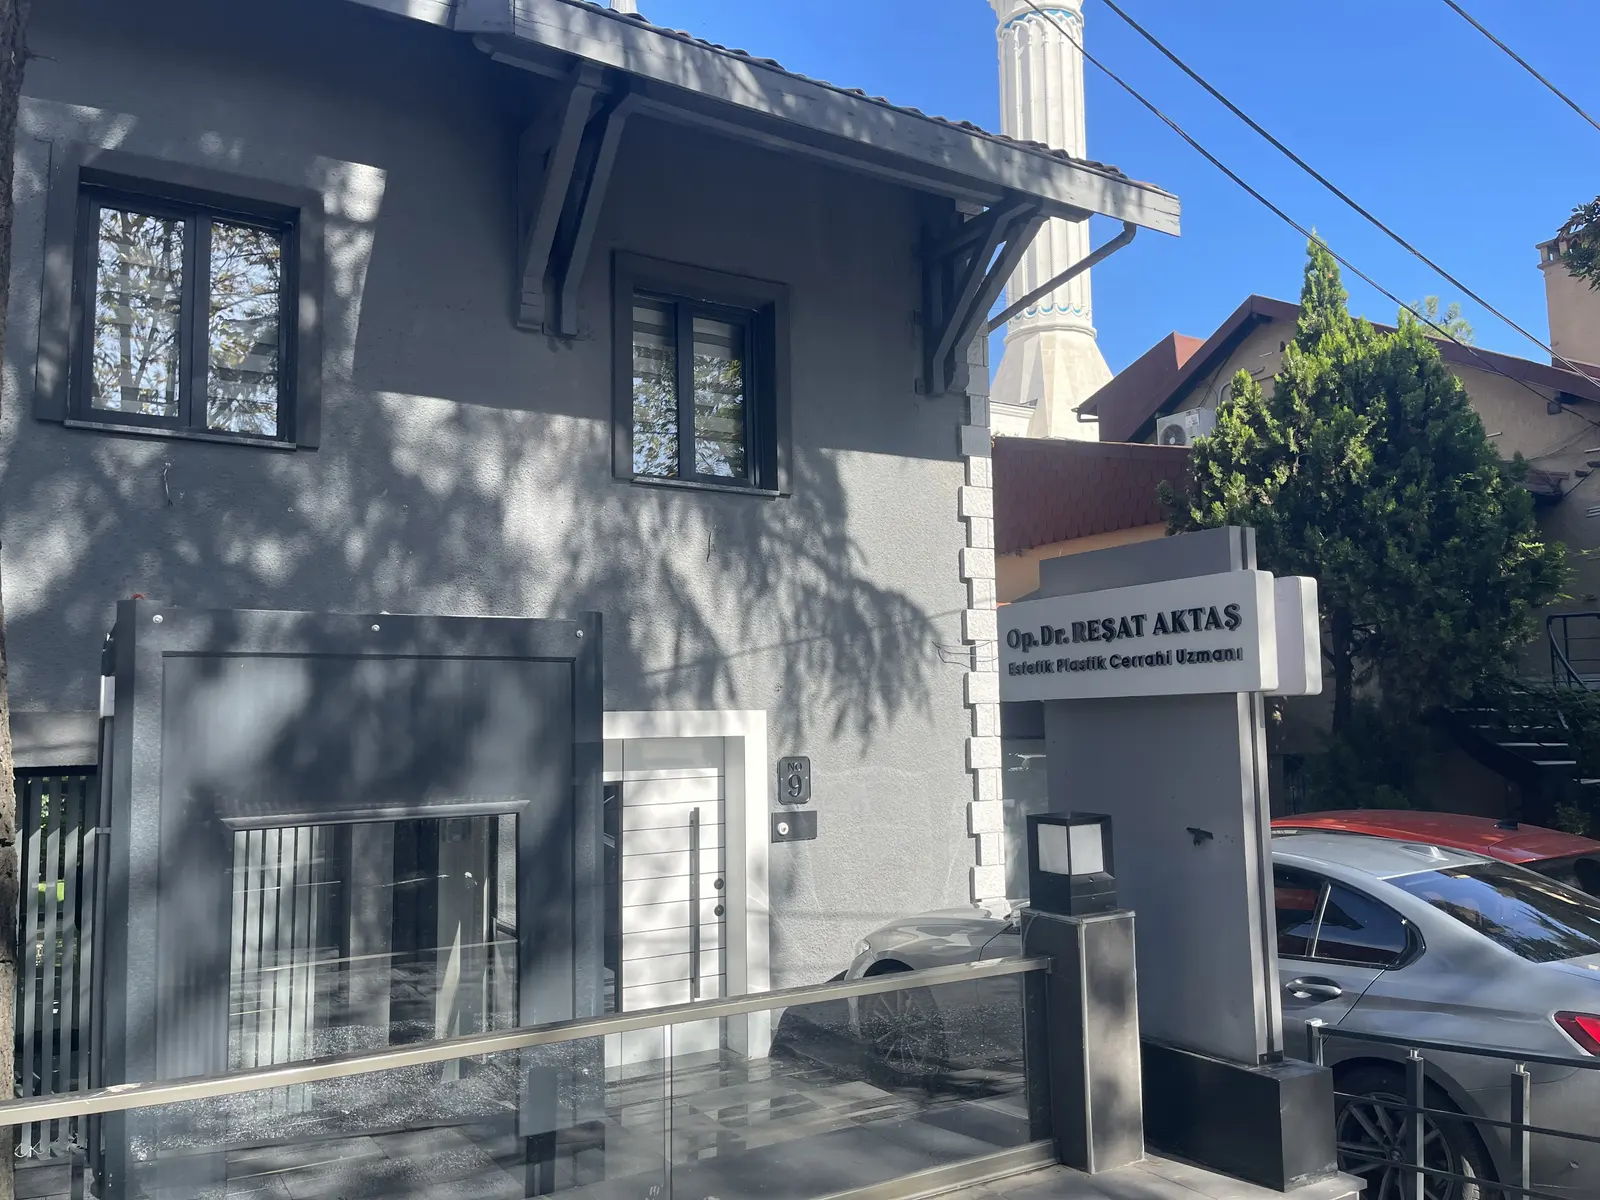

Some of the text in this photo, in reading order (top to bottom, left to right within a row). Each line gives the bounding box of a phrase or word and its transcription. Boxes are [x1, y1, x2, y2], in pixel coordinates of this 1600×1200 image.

[1152, 602, 1243, 636] AKTAŞ
[1008, 647, 1243, 676] Estetik Plastik Cerrahi Uzmanı
[788, 774, 802, 797] 9
